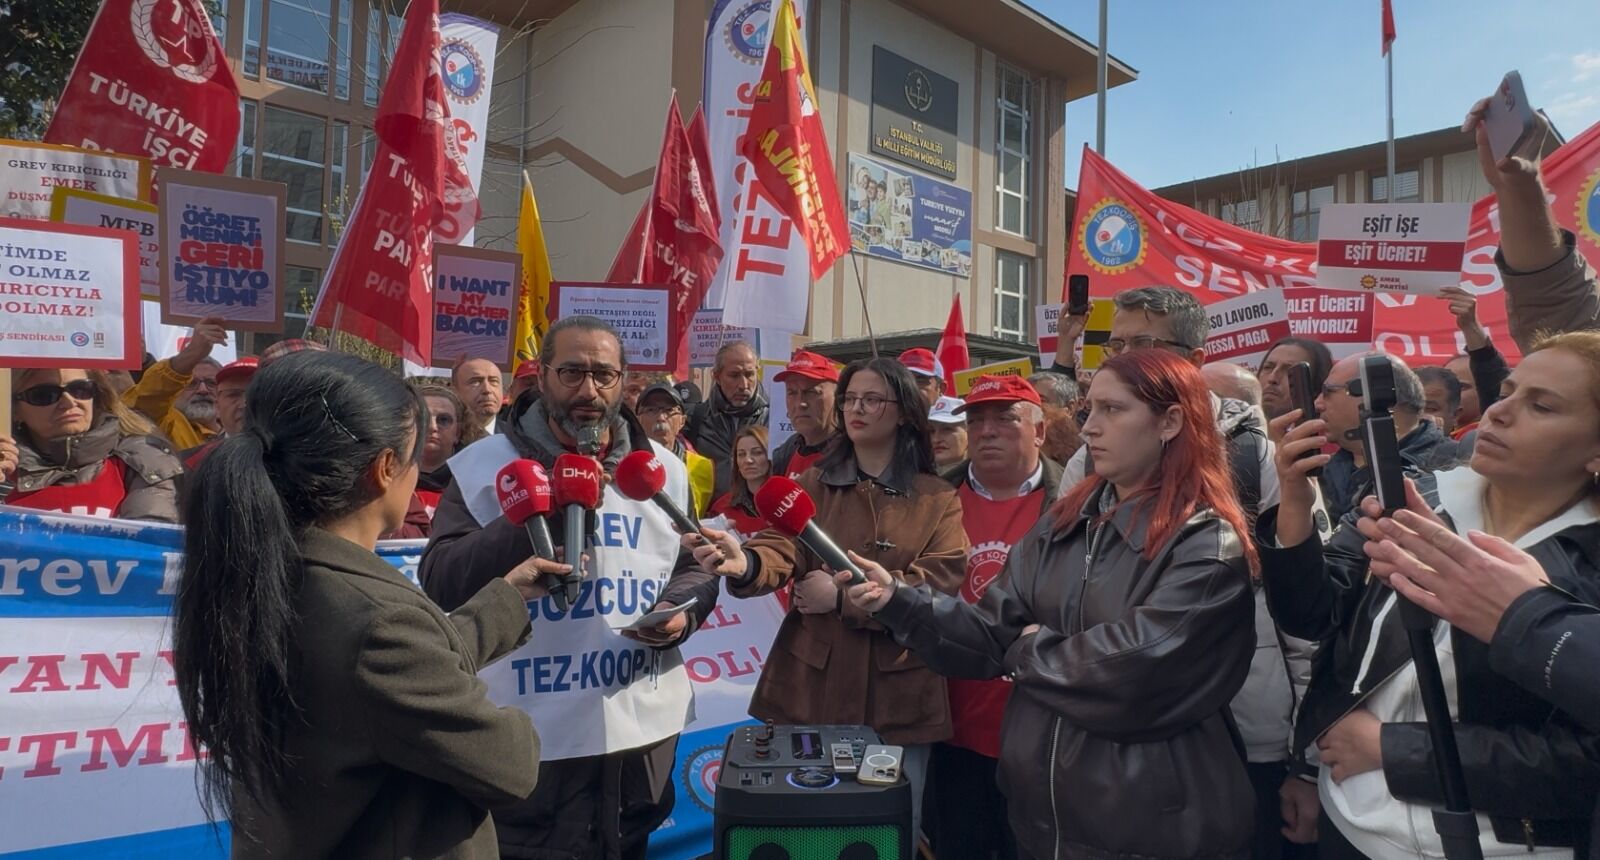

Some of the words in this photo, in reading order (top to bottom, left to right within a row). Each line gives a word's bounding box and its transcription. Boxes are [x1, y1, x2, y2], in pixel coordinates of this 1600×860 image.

[89, 72, 208, 149] TÜRKİYE
[142, 128, 200, 170] İŞÇİ
[889, 126, 919, 146] İSTANBUL
[919, 138, 943, 155] VALİLİĞİ
[883, 138, 899, 153] MİLLİ
[900, 144, 920, 160] EĞİTİM
[921, 153, 955, 173] MÜDÜRLÜĞÜ
[8, 159, 47, 170] GREV
[51, 162, 127, 179] KIRICILIĞI
[41, 176, 97, 191] EMEK
[1362, 214, 1392, 237] EŞİT
[1396, 214, 1419, 238] İŞE
[180, 241, 263, 270] GERİ
[1102, 256, 1121, 265] 1962
[1344, 243, 1373, 264] EŞİT
[1377, 243, 1427, 263] ÜCRET!
[9, 264, 90, 281] OLMAZ
[438, 274, 446, 291] I
[449, 276, 511, 297] WANT
[0, 301, 94, 317] OLMAZ!
[461, 292, 486, 306] MY
[1285, 298, 1315, 313] ALET
[1319, 294, 1365, 312] ÜCRETİ
[436, 301, 509, 319] TEACHER
[573, 308, 630, 317] MESLEKTAŞINI
[632, 309, 656, 317] DEĞİL
[1226, 302, 1274, 325] LAVORO,
[435, 314, 508, 336] BACK!
[1290, 316, 1358, 334] EMİYORUZ!
[7, 331, 65, 342] SENDİKASI
[631, 332, 648, 340] AL!
[1237, 329, 1270, 348] PAGA
[562, 467, 598, 482] DHA
[502, 487, 529, 508] anka
[774, 487, 803, 518] ULUSAL
[0, 557, 139, 596] rev
